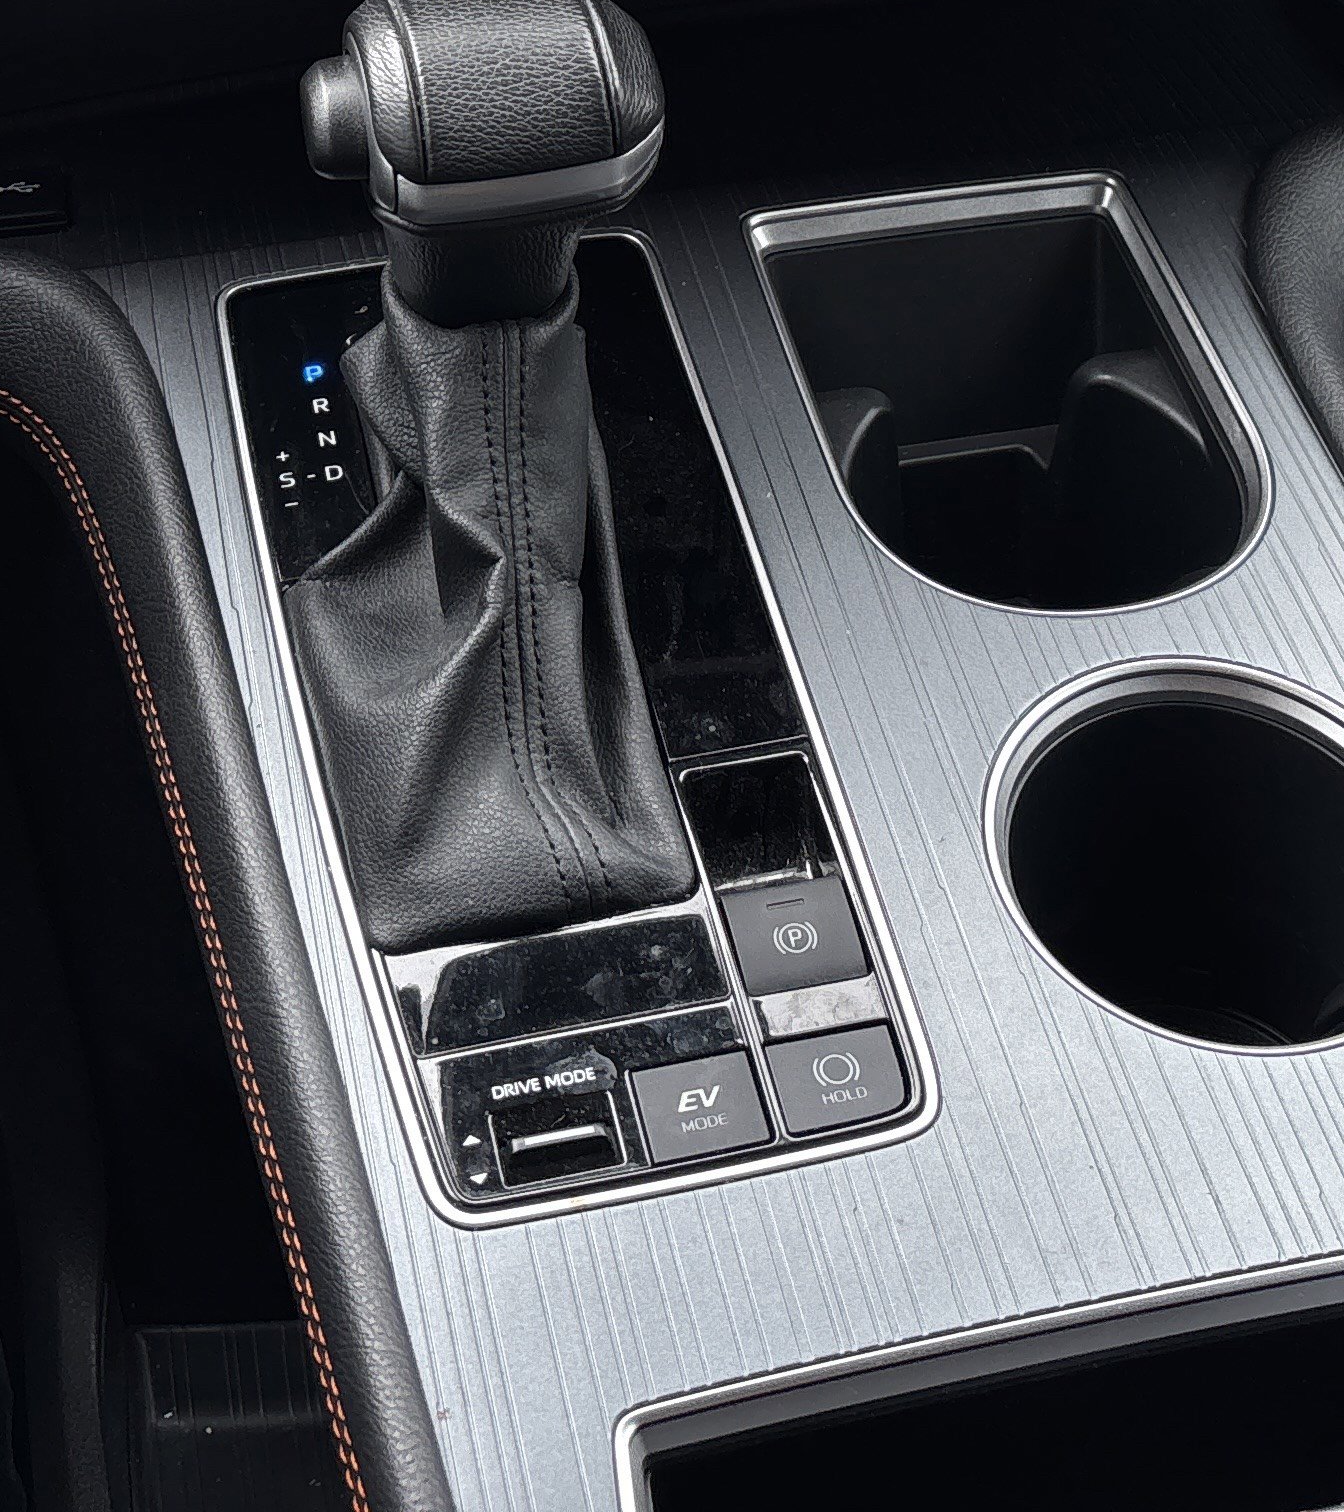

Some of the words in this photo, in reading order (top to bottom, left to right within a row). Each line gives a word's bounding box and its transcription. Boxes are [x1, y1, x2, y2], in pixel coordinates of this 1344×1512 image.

[304, 364, 324, 383] P
[312, 397, 331, 414] R
[317, 430, 338, 448] N
[278, 471, 297, 489] S
[324, 463, 345, 483] D
[491, 1079, 543, 1101] DRIVE
[545, 1066, 598, 1092] MODE
[677, 1084, 723, 1114] EV
[821, 1085, 869, 1105] HOLD
[681, 1112, 730, 1135] MODE
